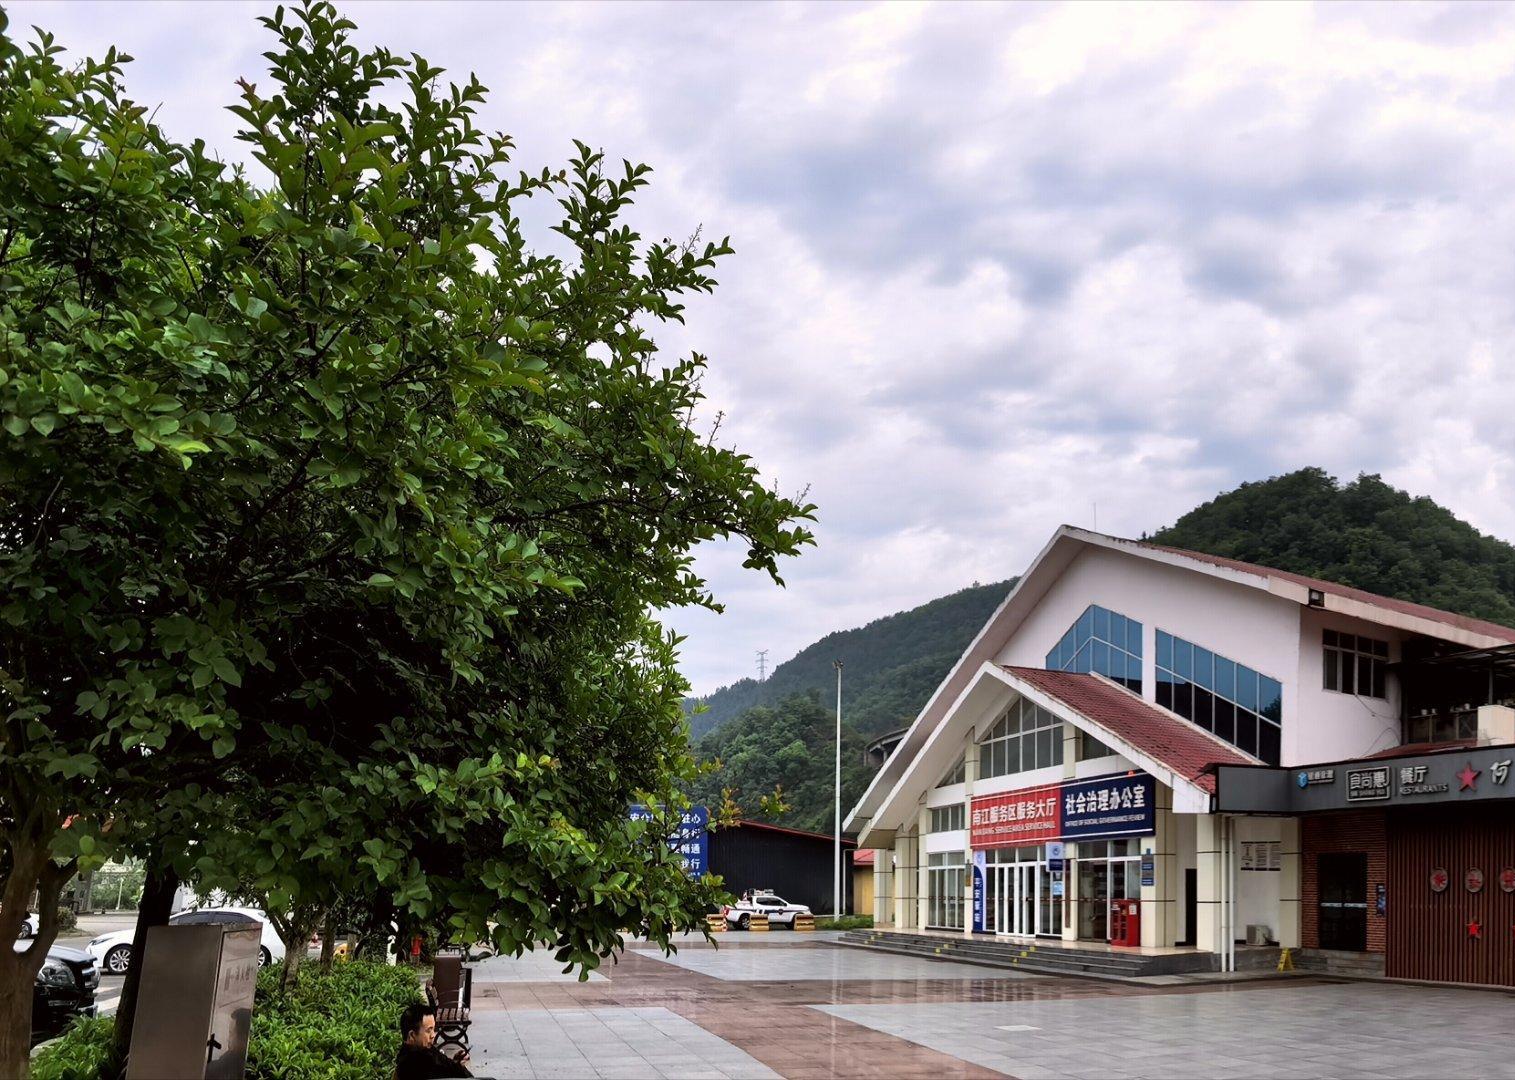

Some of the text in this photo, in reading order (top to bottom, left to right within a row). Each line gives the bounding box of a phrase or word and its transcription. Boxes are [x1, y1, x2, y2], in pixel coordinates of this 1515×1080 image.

[1350, 771, 1388, 791] 食尚惠
[1400, 766, 1428, 784] 餐厅
[972, 796, 1057, 827] 南江服务区服务大厅
[1065, 784, 1146, 816] 社会治理办公室
